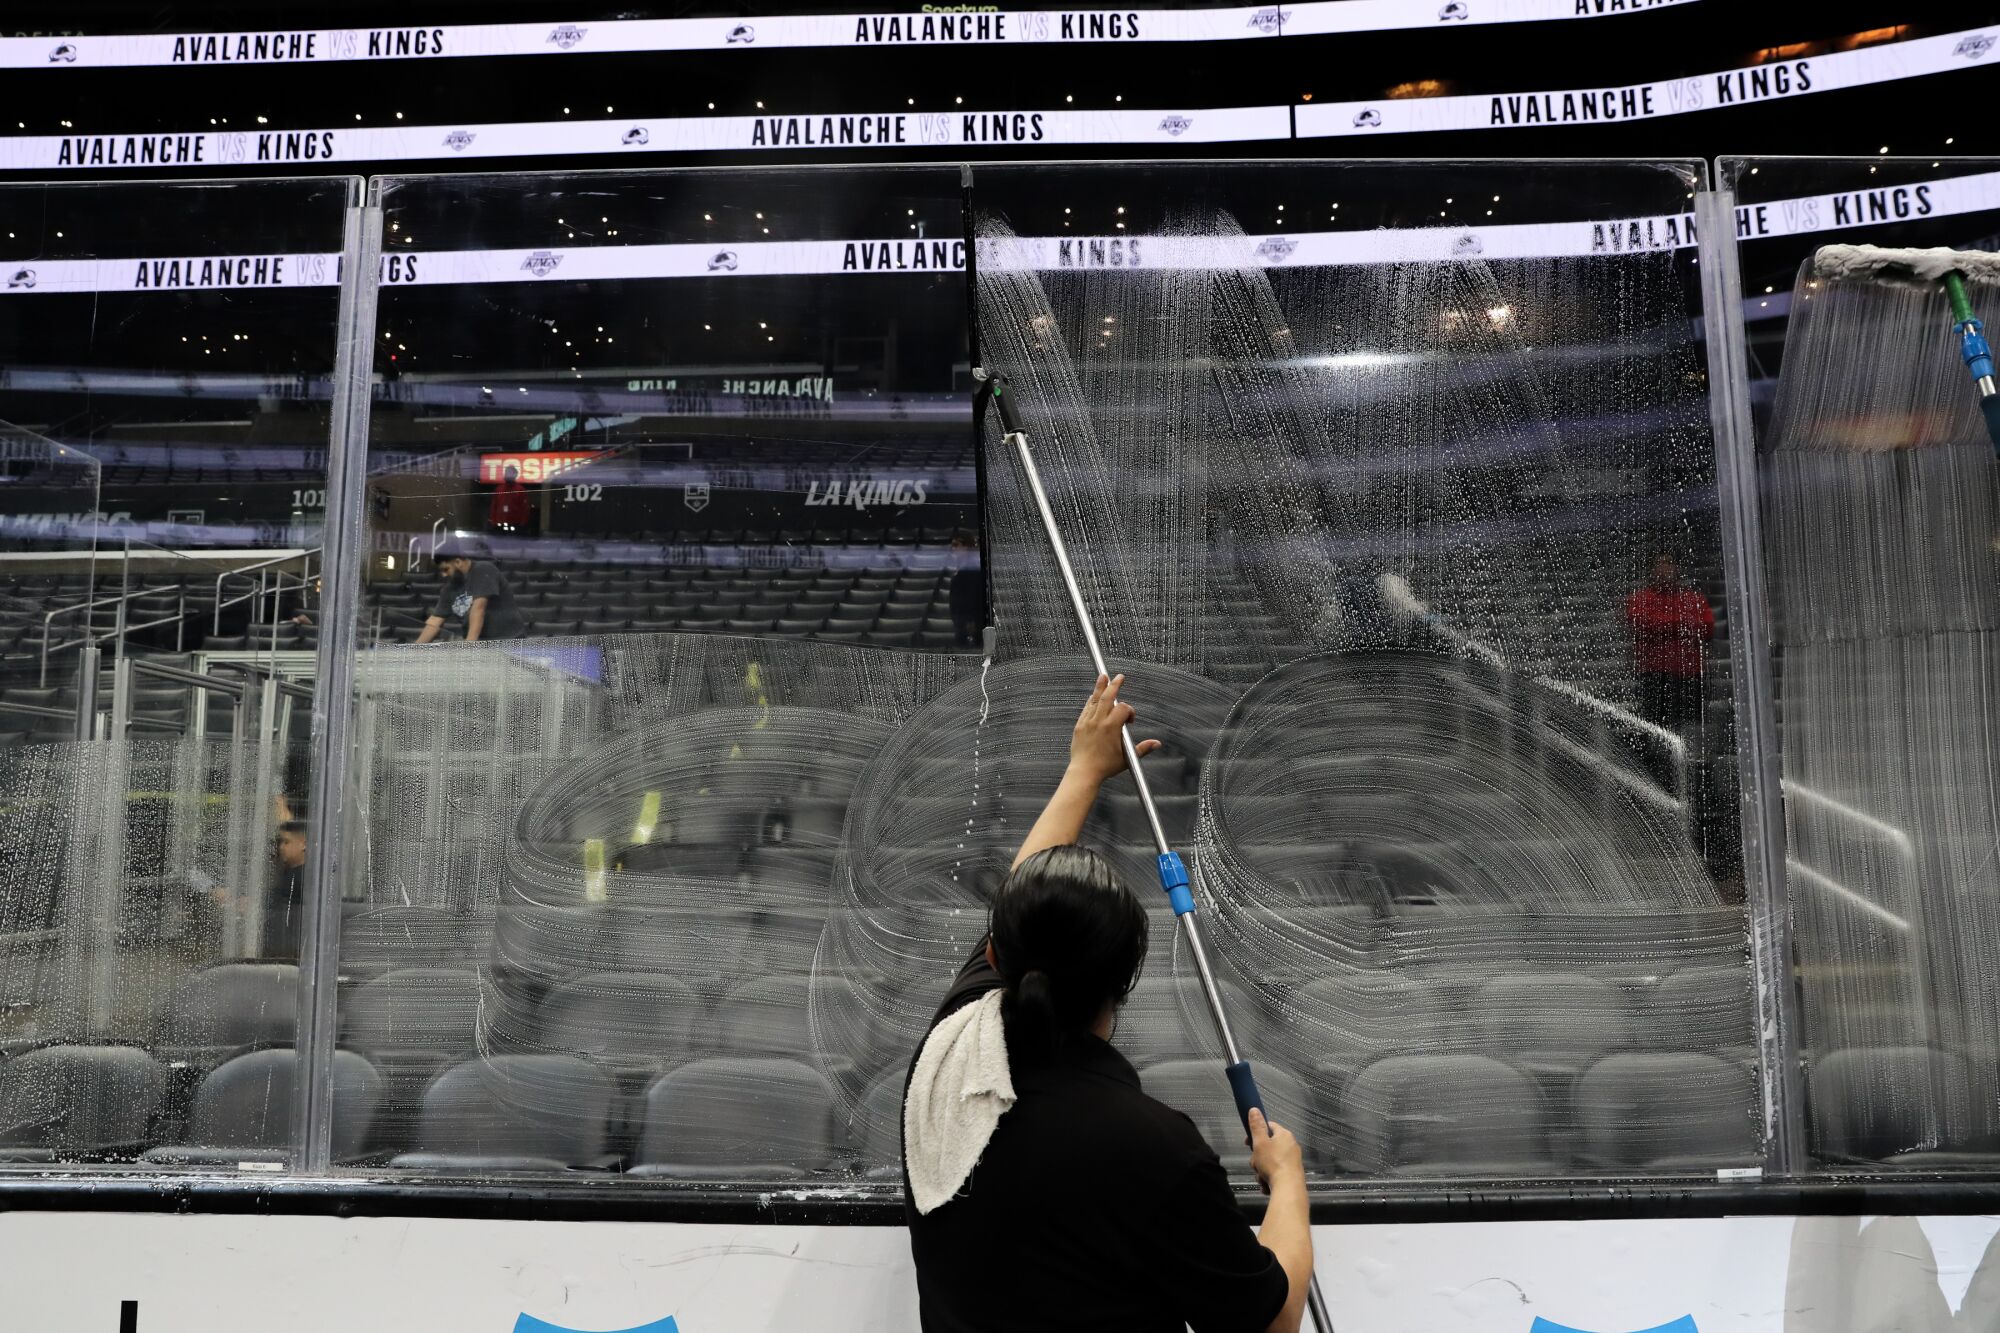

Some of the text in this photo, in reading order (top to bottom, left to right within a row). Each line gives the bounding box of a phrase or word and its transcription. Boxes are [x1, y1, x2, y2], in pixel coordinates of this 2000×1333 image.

[855, 12, 1139, 42] AVALANCHE VS KINGS
[172, 29, 444, 62] AVALANCHE VS KINGS
[1490, 62, 1811, 125] AVALANCHE VS KINGS
[752, 113, 1044, 146] AVALANCHE VS KINGS
[58, 132, 334, 165] AVALANCHE VS KINGS
[1592, 185, 1933, 252] AVALANHE VS KINGS
[842, 240, 999, 271] AVALANC
[1059, 238, 1142, 267] KINGS
[135, 257, 284, 288] AVALANCHE
[296, 257, 326, 285] VS
[484, 458, 592, 481] TOSH
[291, 489, 326, 507] 101
[563, 483, 602, 502] 102
[804, 479, 930, 511] LA KINGS
